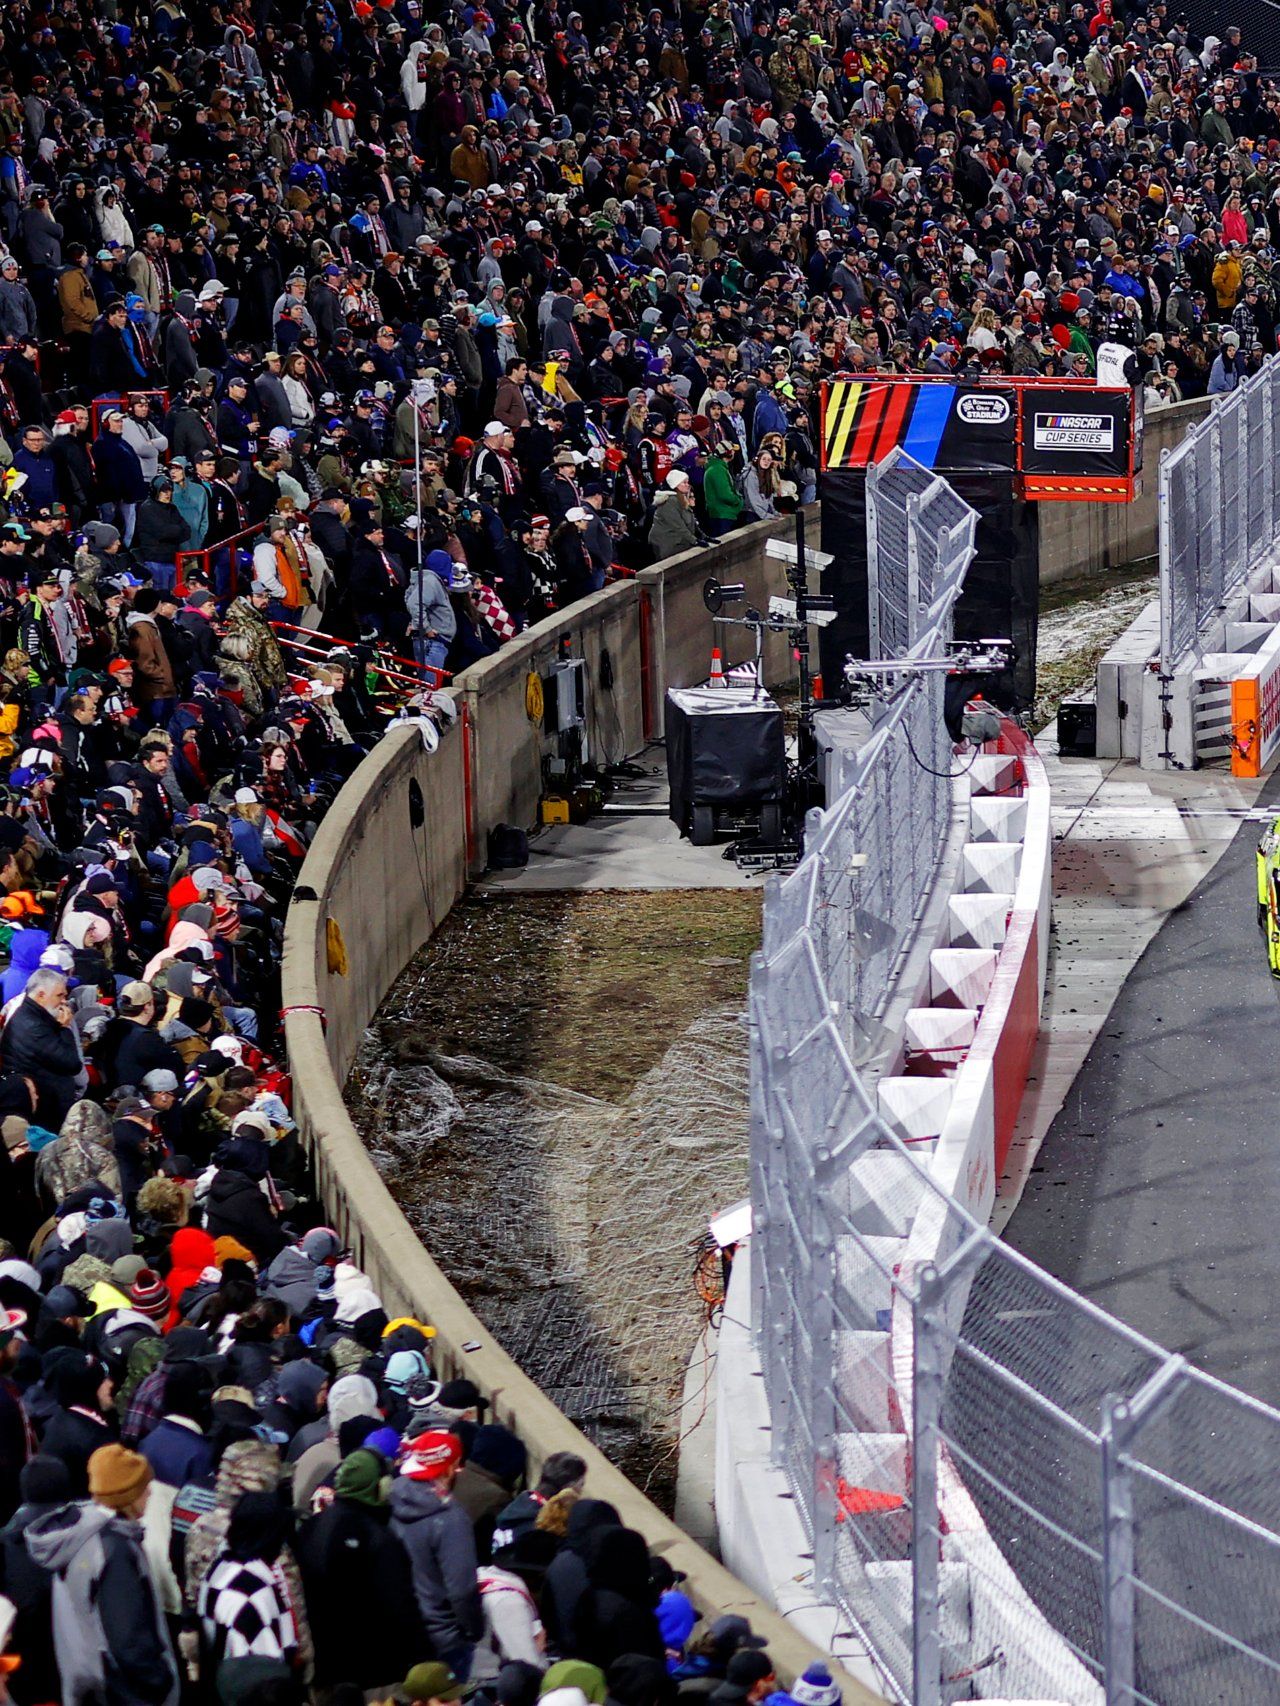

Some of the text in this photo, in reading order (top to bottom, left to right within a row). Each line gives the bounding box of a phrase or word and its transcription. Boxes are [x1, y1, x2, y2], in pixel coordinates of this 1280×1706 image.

[966, 411, 1001, 419] STADIUM
[1060, 416, 1102, 429] NASCAR
[1045, 432, 1101, 444] CUP SERIES
